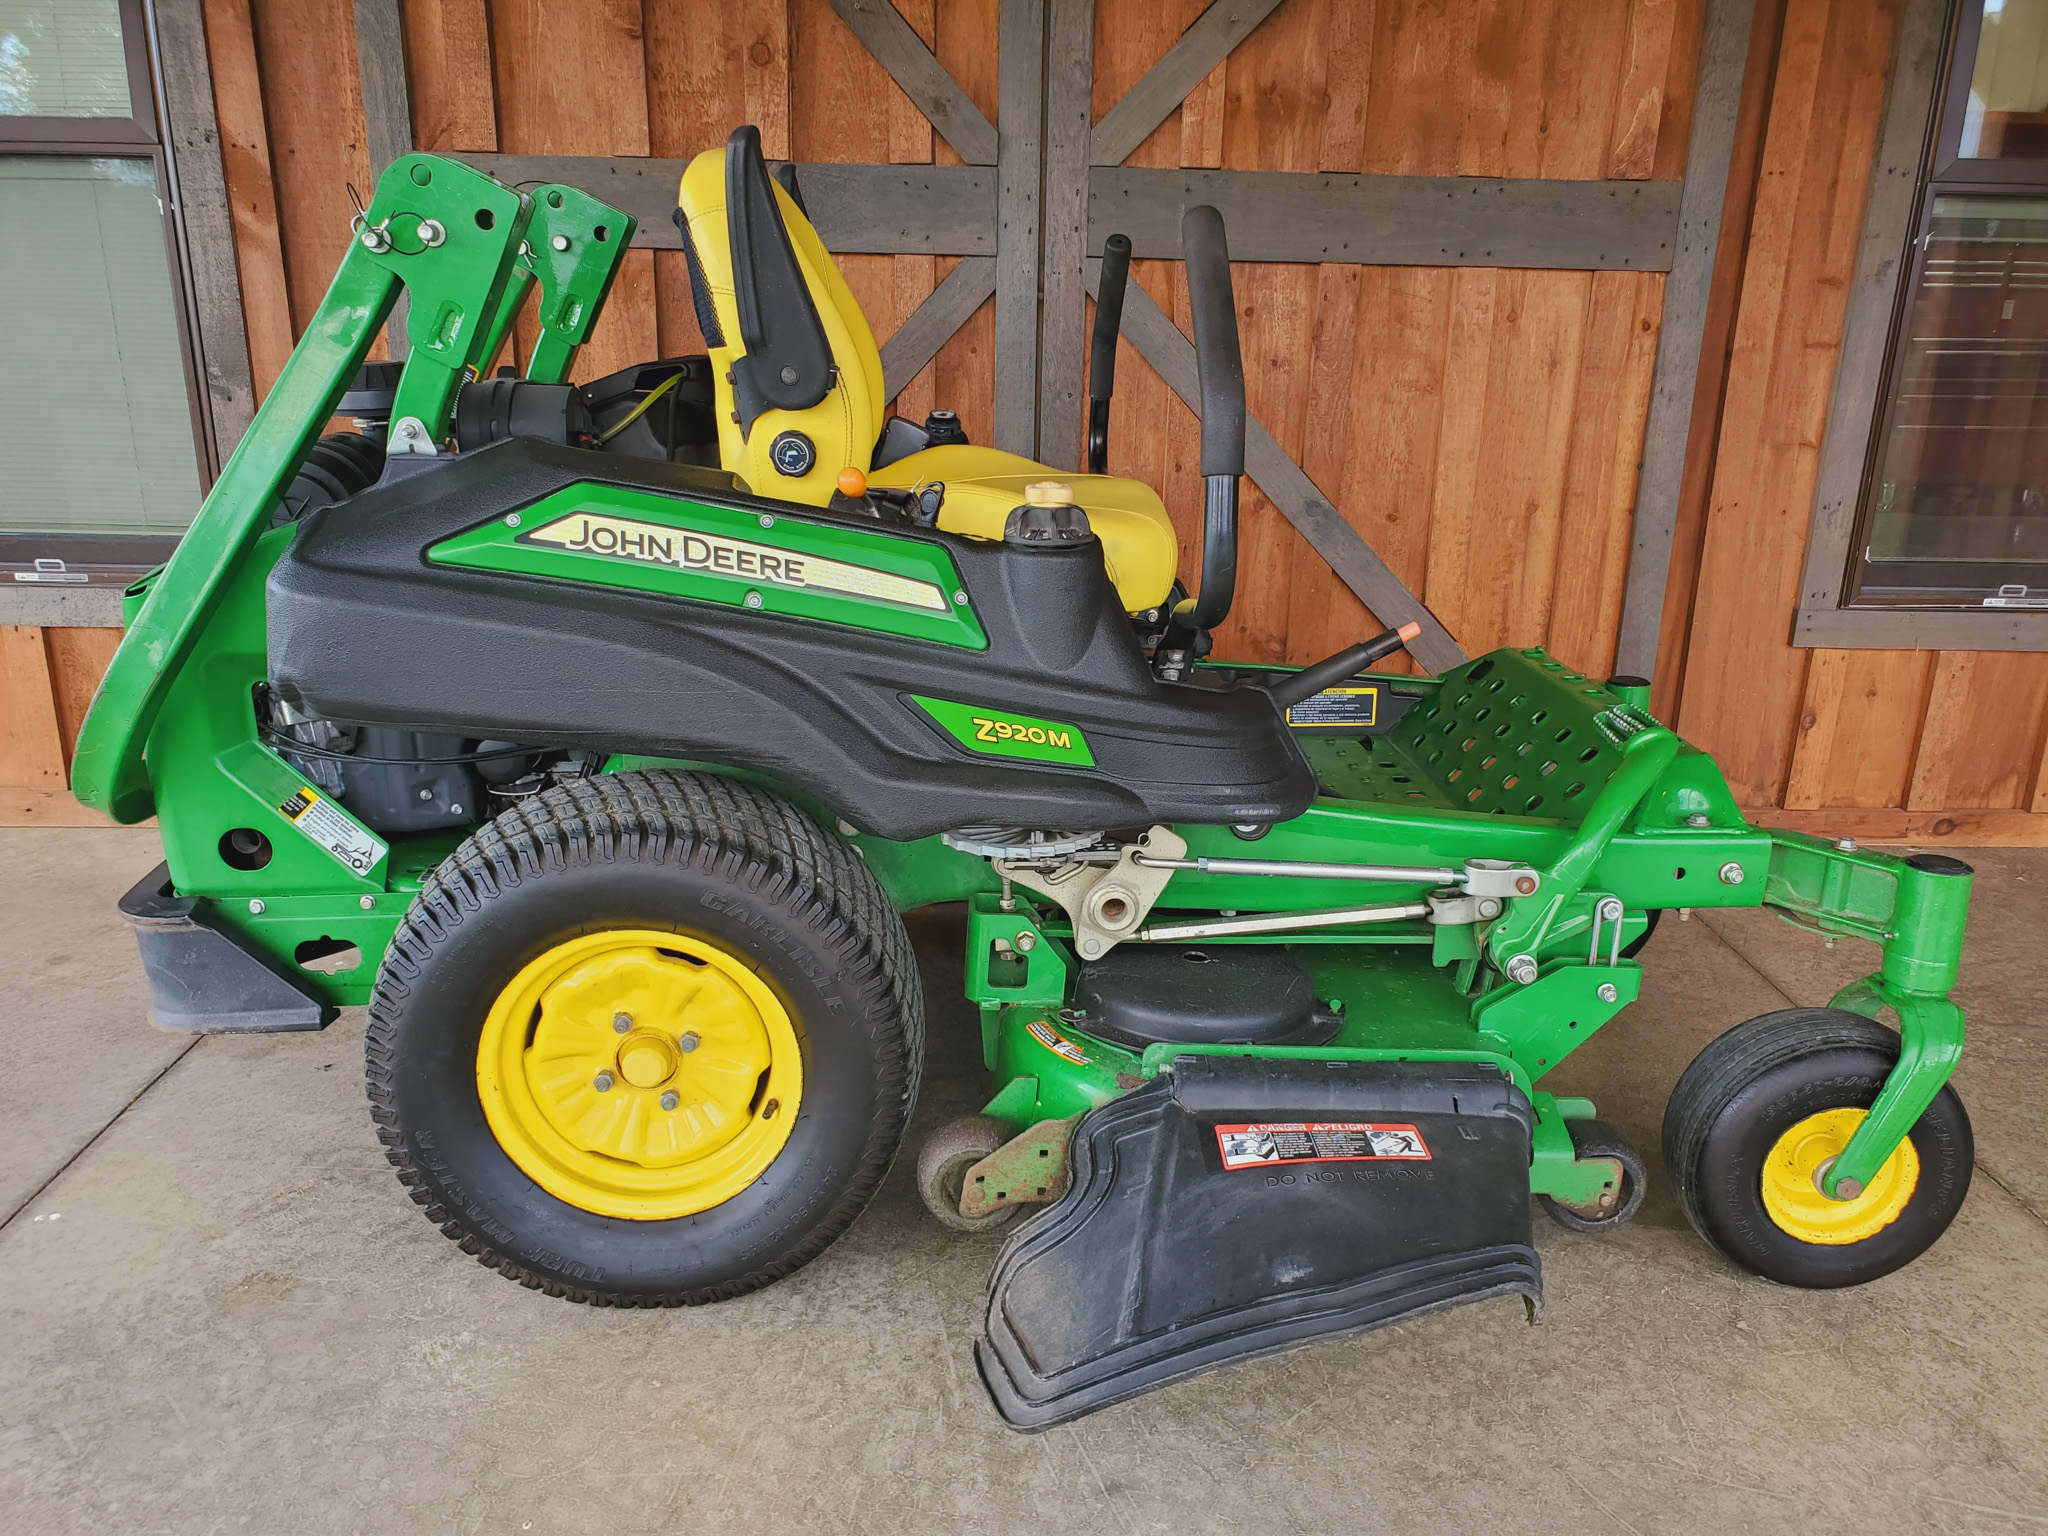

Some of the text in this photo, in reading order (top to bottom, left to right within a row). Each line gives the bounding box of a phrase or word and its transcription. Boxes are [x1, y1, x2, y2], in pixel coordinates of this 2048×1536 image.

[568, 518, 806, 585] JOHN DEERE
[971, 717, 1072, 750] Z920M
[1258, 1122, 1373, 1132] DANGER PELIGRO
[1265, 1170, 1437, 1189] DO NOT REMOVE
